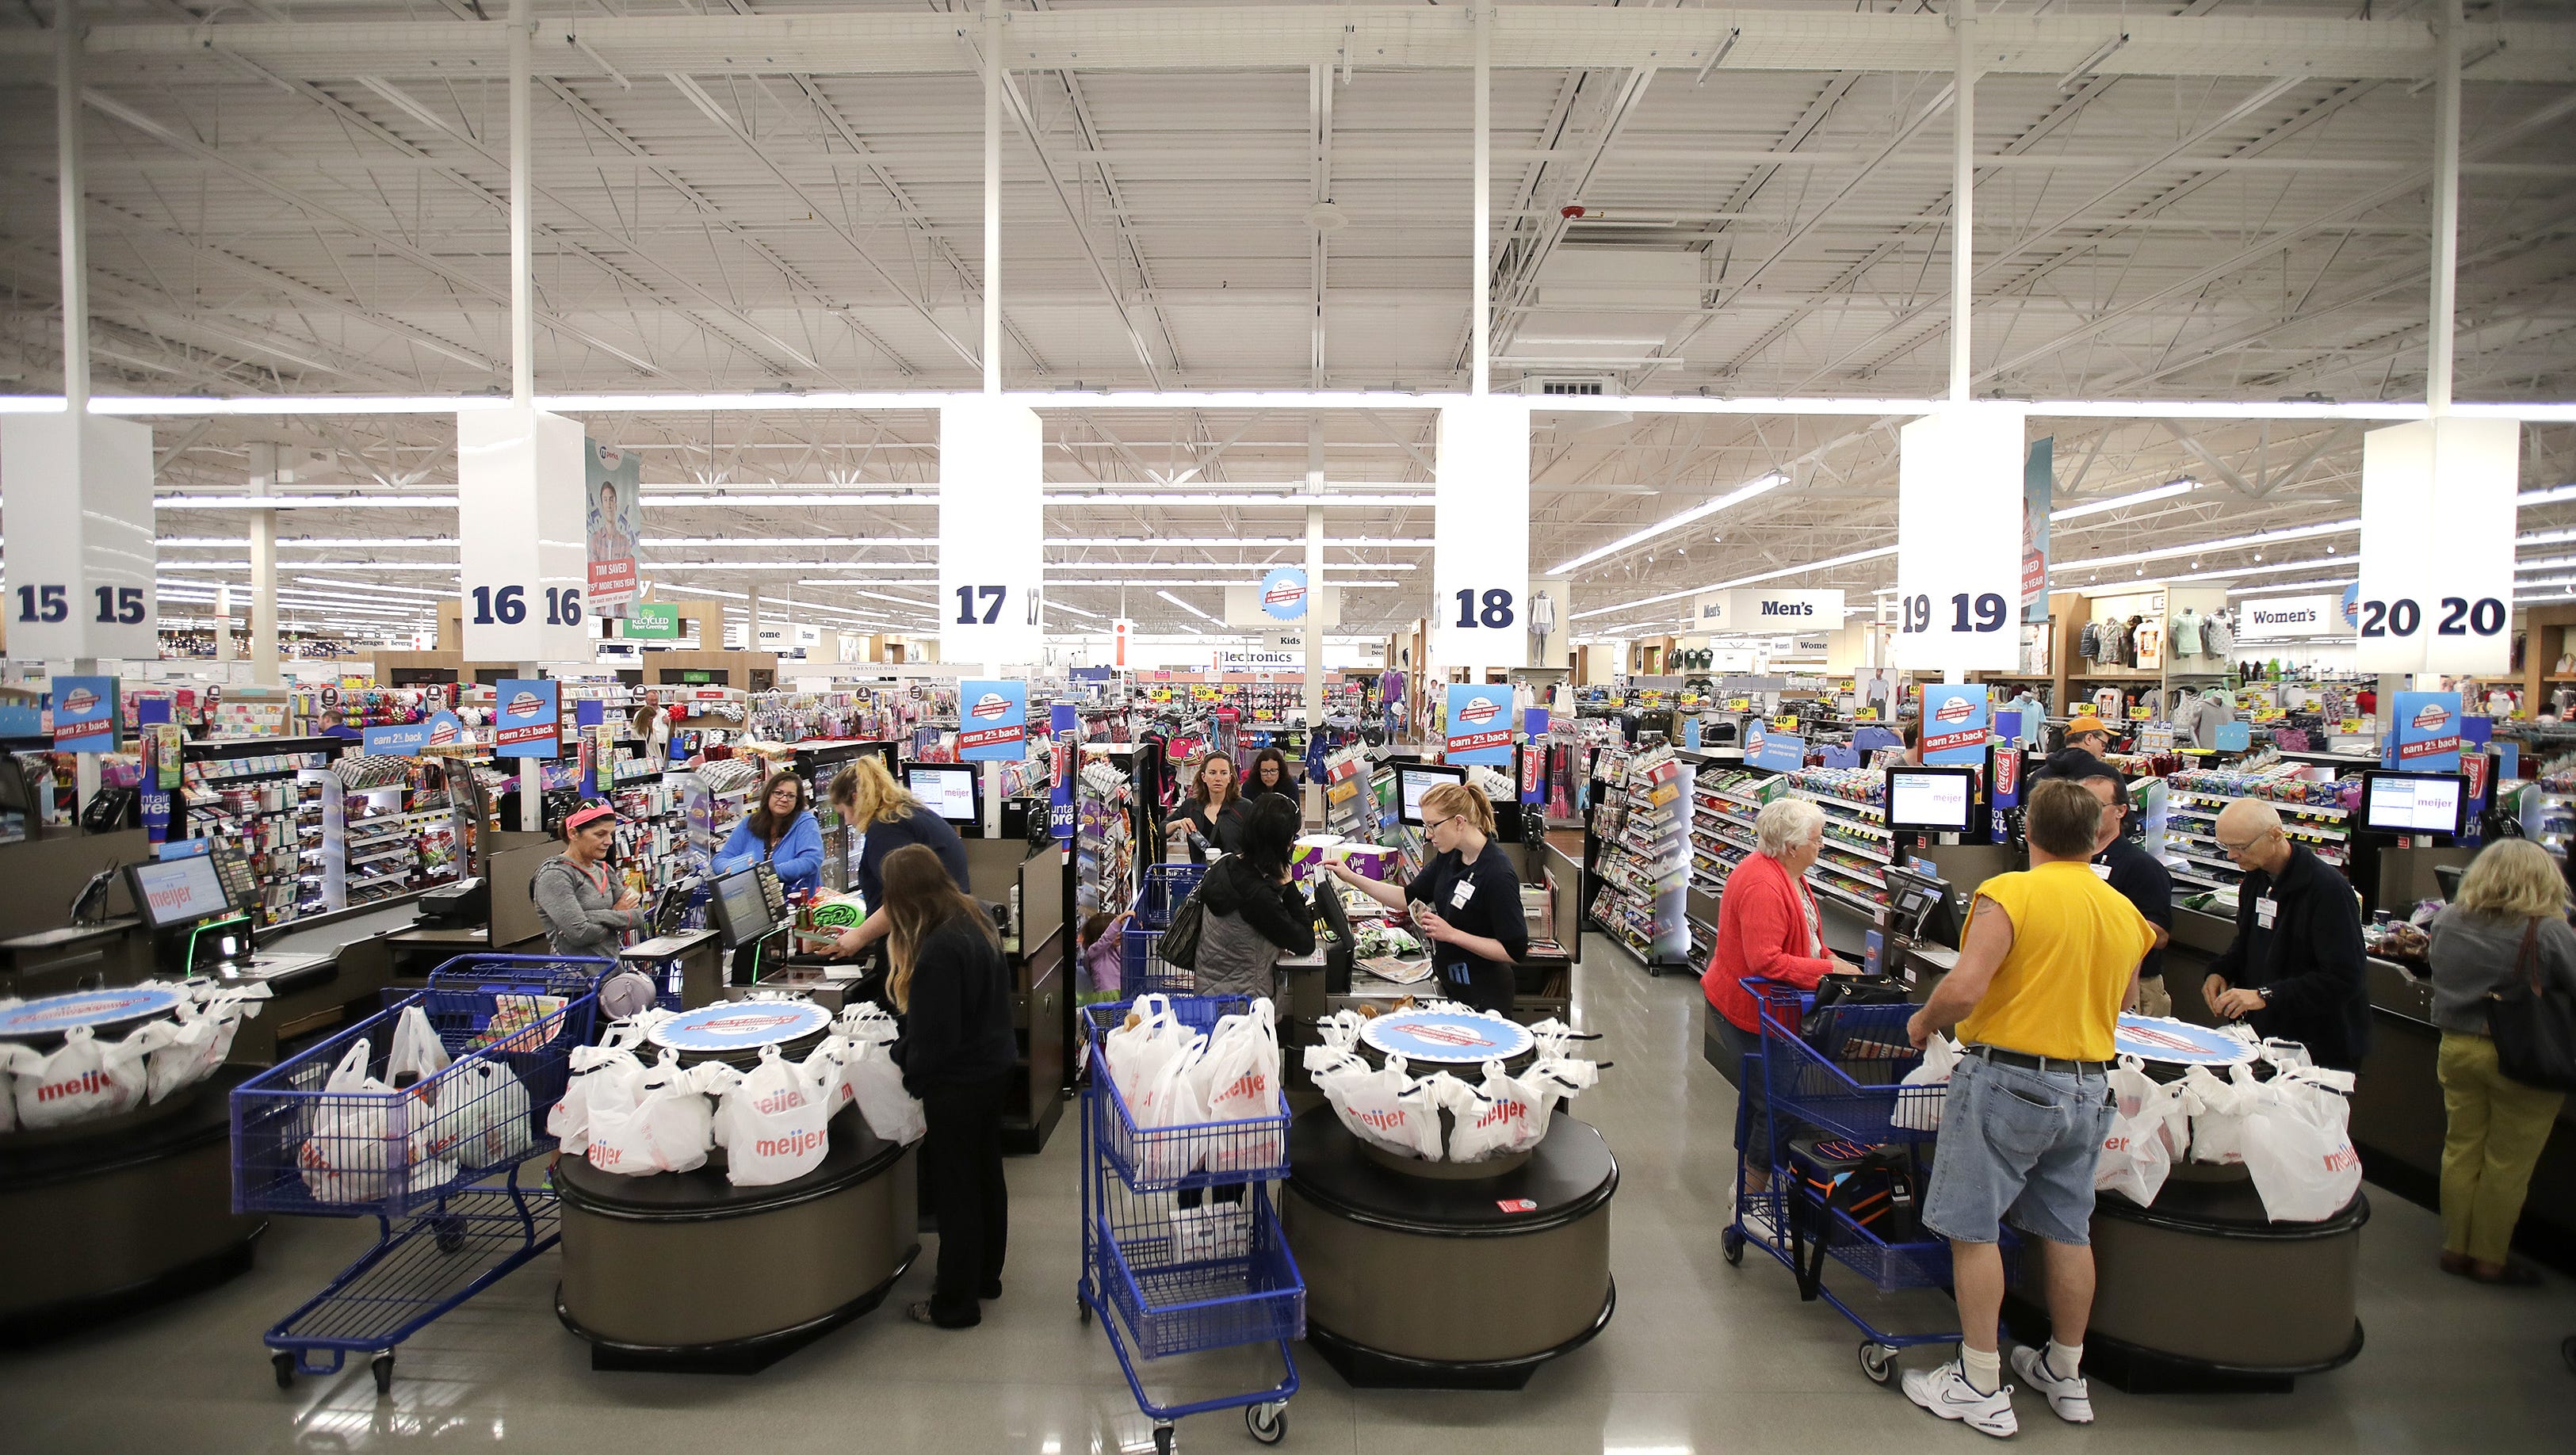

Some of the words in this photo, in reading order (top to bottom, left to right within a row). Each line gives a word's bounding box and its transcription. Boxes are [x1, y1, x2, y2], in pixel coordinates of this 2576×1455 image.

[595, 565, 607, 576] TIM
[608, 563, 627, 575] SAVED
[2022, 559, 2039, 575] AVED
[599, 580, 613, 590] MORE
[613, 579, 624, 589] THIS
[624, 578, 636, 587] YEAR
[2029, 576, 2043, 588] YEAR
[17, 585, 68, 623] 15
[95, 586, 146, 624] 15
[472, 585, 526, 624] 16
[545, 587, 582, 627] 16
[957, 586, 1006, 624] 17
[1027, 587, 1039, 625] 17
[1456, 589, 1514, 629] 18
[1703, 604, 1720, 618] Men's
[1761, 601, 1814, 616] Men's
[1903, 594, 1930, 633] 19
[1951, 593, 2007, 632] 19
[2253, 609, 2316, 624] Women's
[2361, 598, 2421, 637] 20
[2438, 597, 2505, 636] 20
[1280, 636, 1301, 645] Kids
[1221, 651, 1292, 663] lectronics
[56, 727, 75, 736] earn
[89, 719, 109, 731] back
[499, 731, 518, 740] earn
[519, 728, 532, 738] 2%
[533, 724, 554, 735] back
[963, 734, 983, 743] earn
[984, 729, 999, 740] 2%
[999, 727, 1021, 738] back
[373, 735, 392, 745] earn
[404, 731, 422, 742] back
[1450, 738, 1471, 747] earn
[1473, 734, 1486, 745] 2%
[1487, 731, 1509, 743] back
[1927, 737, 1947, 747] earn
[1948, 733, 1962, 744] 2%
[1963, 730, 1983, 742] back
[2402, 744, 2423, 754] earn
[2425, 740, 2437, 751] 2%
[2438, 737, 2457, 749] back
[945, 789, 969, 798] meijer
[1933, 793, 1961, 803] meijer
[2417, 798, 2452, 808] meijer
[1301, 861, 1317, 875] Viv
[1350, 857, 1366, 870] Viva
[148, 883, 192, 910] meijer
[38, 1070, 112, 1102] meij
[756, 1128, 826, 1157] meijer
[587, 1139, 624, 1167] eijer
